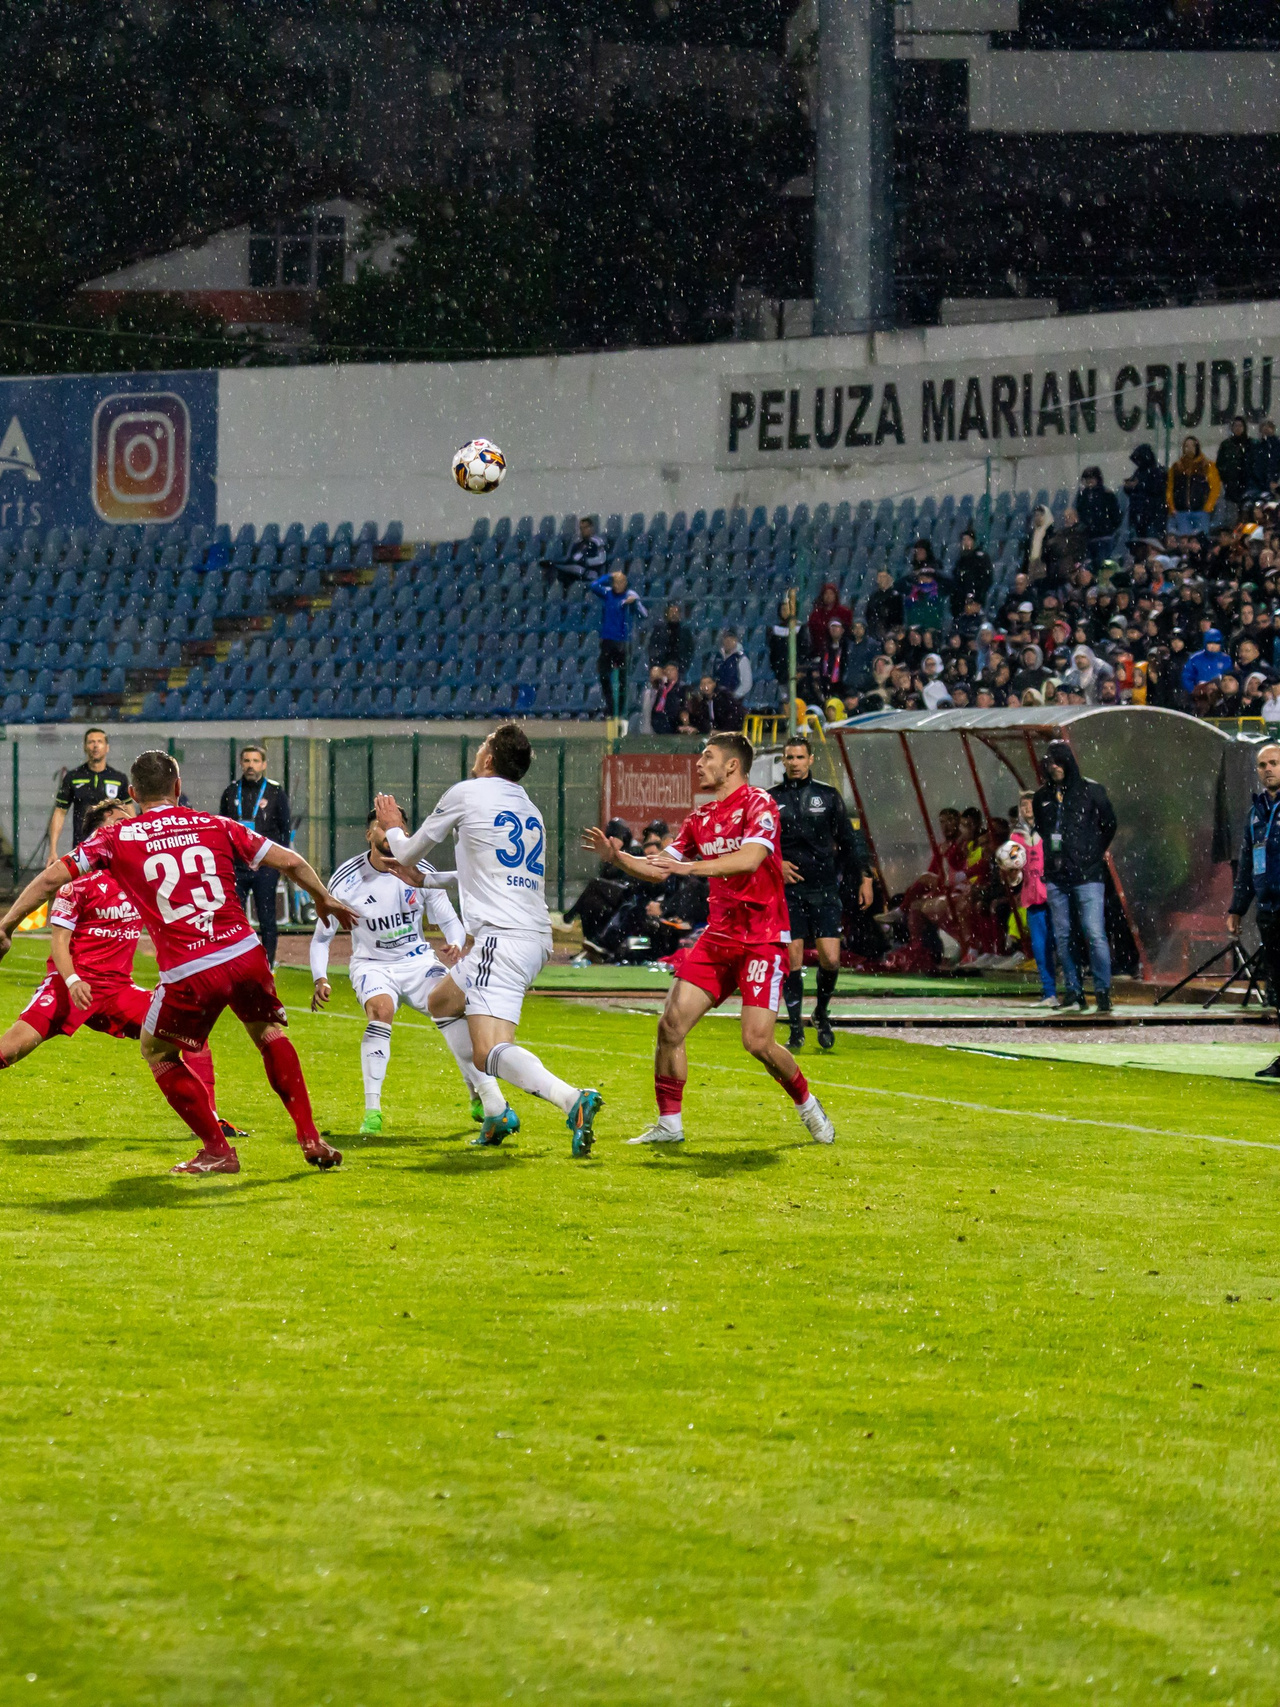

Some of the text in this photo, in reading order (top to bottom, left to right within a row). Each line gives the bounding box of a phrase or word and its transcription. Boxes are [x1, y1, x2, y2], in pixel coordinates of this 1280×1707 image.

[727, 355, 1276, 454] PELUZA MARIAN CRUDU
[132, 815, 211, 835] Regata.ro
[145, 833, 201, 853] PATRICHE
[493, 810, 545, 877] 32
[143, 845, 226, 925] 23
[506, 875, 540, 891] SERONI
[365, 909, 419, 932] UNIBET
[746, 959, 769, 984] 98
